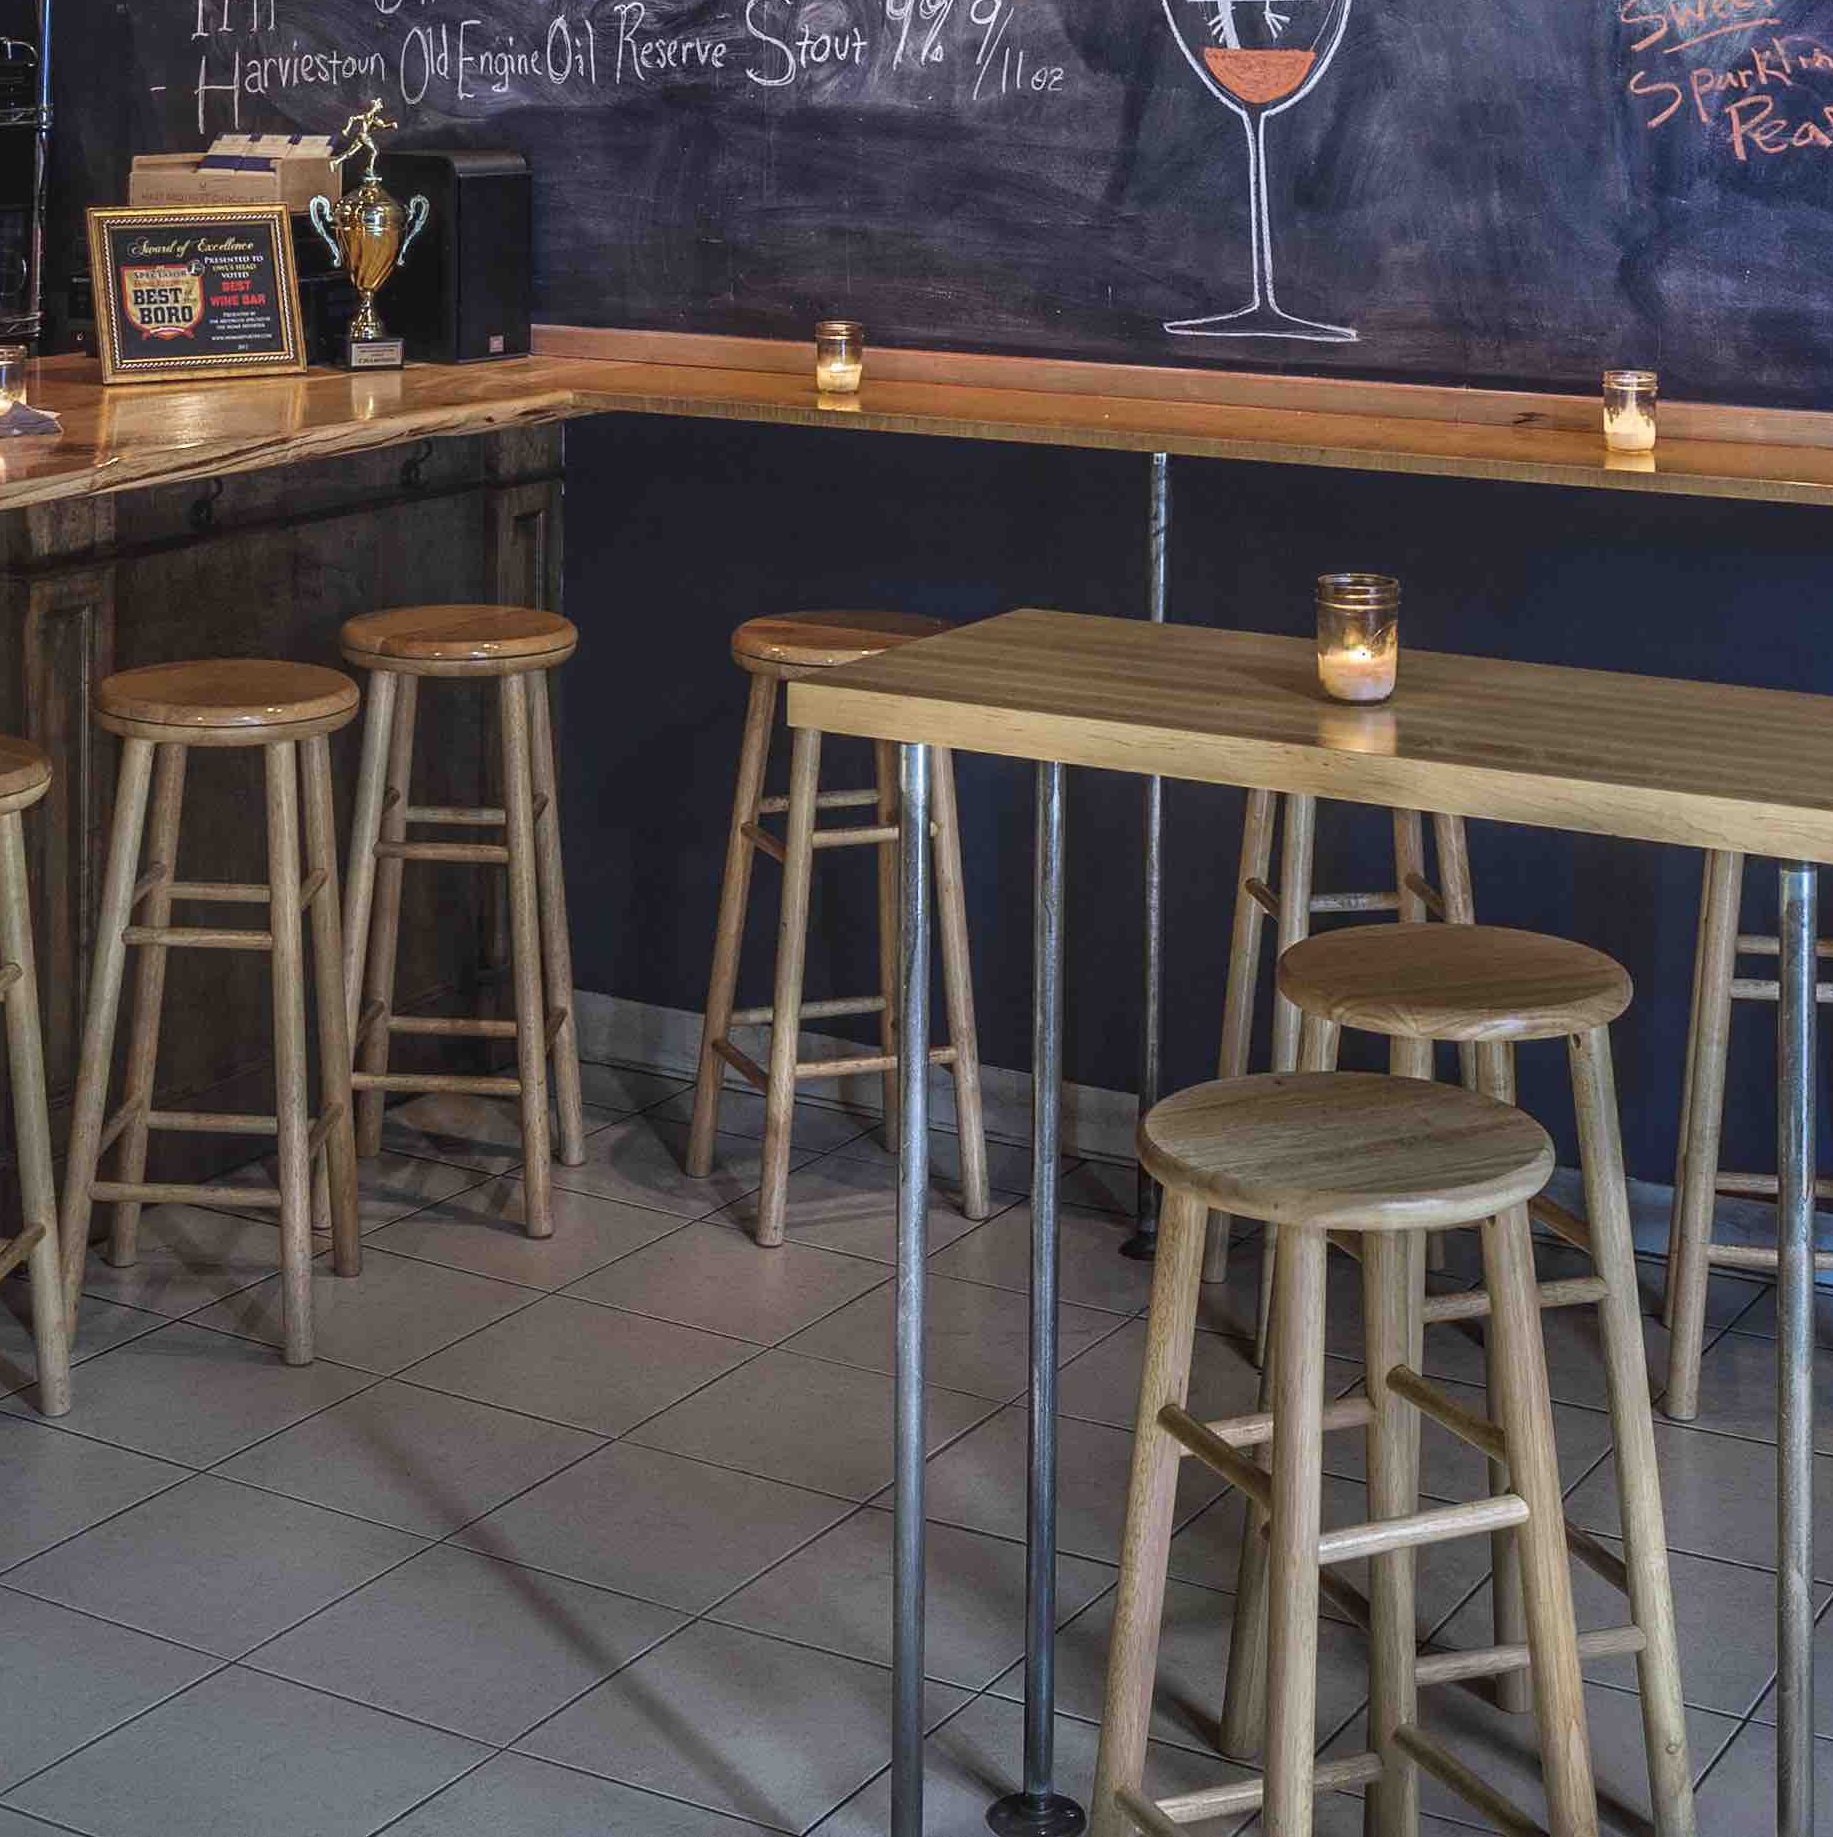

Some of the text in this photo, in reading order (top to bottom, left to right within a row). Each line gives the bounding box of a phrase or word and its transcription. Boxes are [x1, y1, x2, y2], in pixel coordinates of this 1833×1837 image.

[400, 23, 450, 104] Old
[458, 20, 542, 100] Engine
[614, 2, 726, 84] Reserve
[133, 287, 183, 306] BEST
[139, 305, 193, 326] BORO
